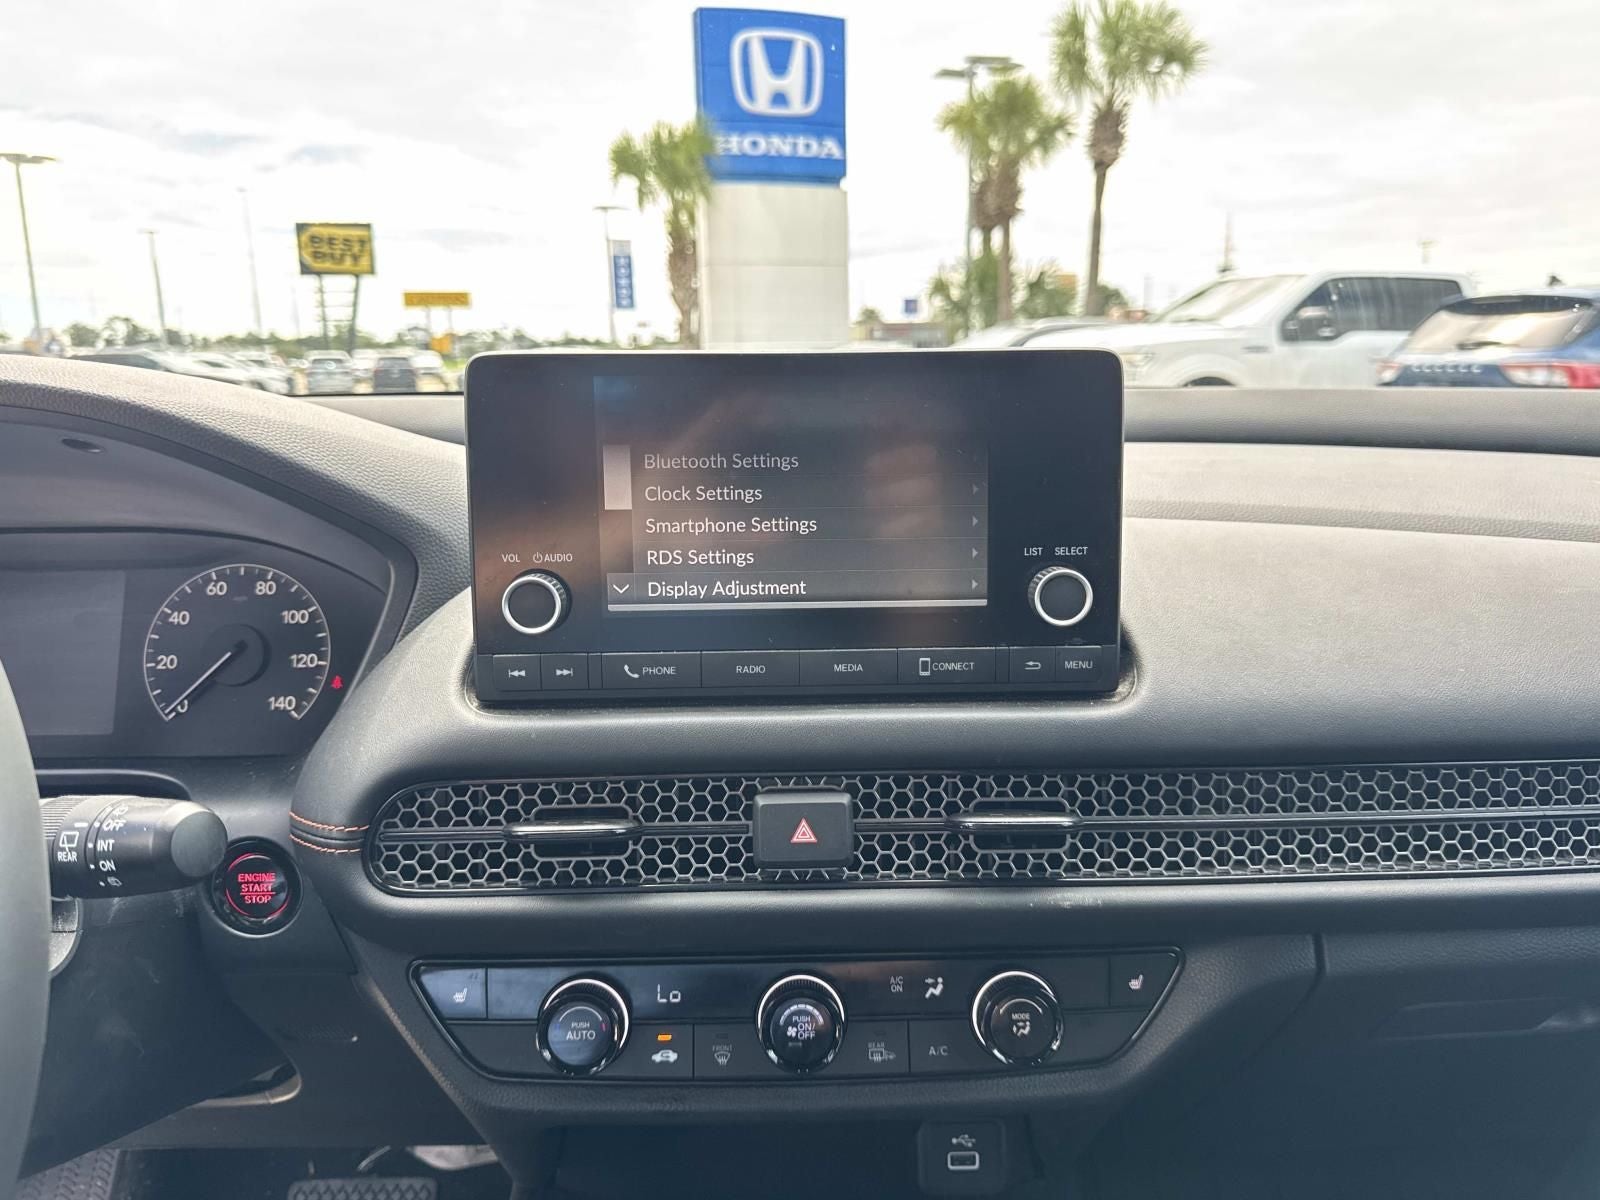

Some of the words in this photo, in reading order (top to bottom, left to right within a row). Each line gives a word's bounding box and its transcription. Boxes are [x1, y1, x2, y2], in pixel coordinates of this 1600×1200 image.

[716, 133, 844, 159] HONDA
[309, 234, 368, 252] BEST
[643, 453, 727, 470] Bluetooth
[732, 453, 799, 471] Settings
[644, 485, 690, 501] Clock
[696, 485, 763, 503] Settings
[645, 518, 746, 535] Smartphone
[751, 516, 817, 534] Settings
[1024, 547, 1043, 556] LIST
[1054, 546, 1088, 556] SELECT
[501, 553, 521, 563] VOL
[544, 553, 573, 563] AUDIO
[647, 550, 683, 565] RDS
[688, 549, 754, 567] Settings
[206, 581, 228, 596] 60
[255, 580, 277, 595] 80
[648, 581, 708, 598] Display
[712, 580, 807, 598] Adjustment
[168, 610, 191, 625] 40
[281, 609, 309, 624] 100
[156, 654, 178, 669] 20
[290, 653, 318, 668] 120
[1064, 660, 1094, 670] MENU
[642, 666, 677, 676] PHONE
[735, 665, 766, 675] RADIO
[833, 663, 864, 673] MEDIA
[932, 661, 975, 672] CONNECT
[269, 695, 296, 710] 140
[102, 819, 126, 831] OFF
[97, 839, 115, 852] INT
[57, 851, 79, 863] REAR
[99, 859, 117, 872] ON
[237, 872, 276, 883] ENGINE
[241, 883, 273, 892] START
[244, 895, 272, 904] STOP
[889, 975, 904, 985] A/C
[890, 984, 904, 993] ON
[792, 1015, 811, 1023] PUSH
[1011, 1012, 1031, 1020] MODE
[571, 1021, 591, 1029] PUSH
[797, 1022, 816, 1032] ON/
[566, 1030, 596, 1041] AUTO
[797, 1031, 816, 1040] OFF
[928, 1045, 949, 1057] A/C
